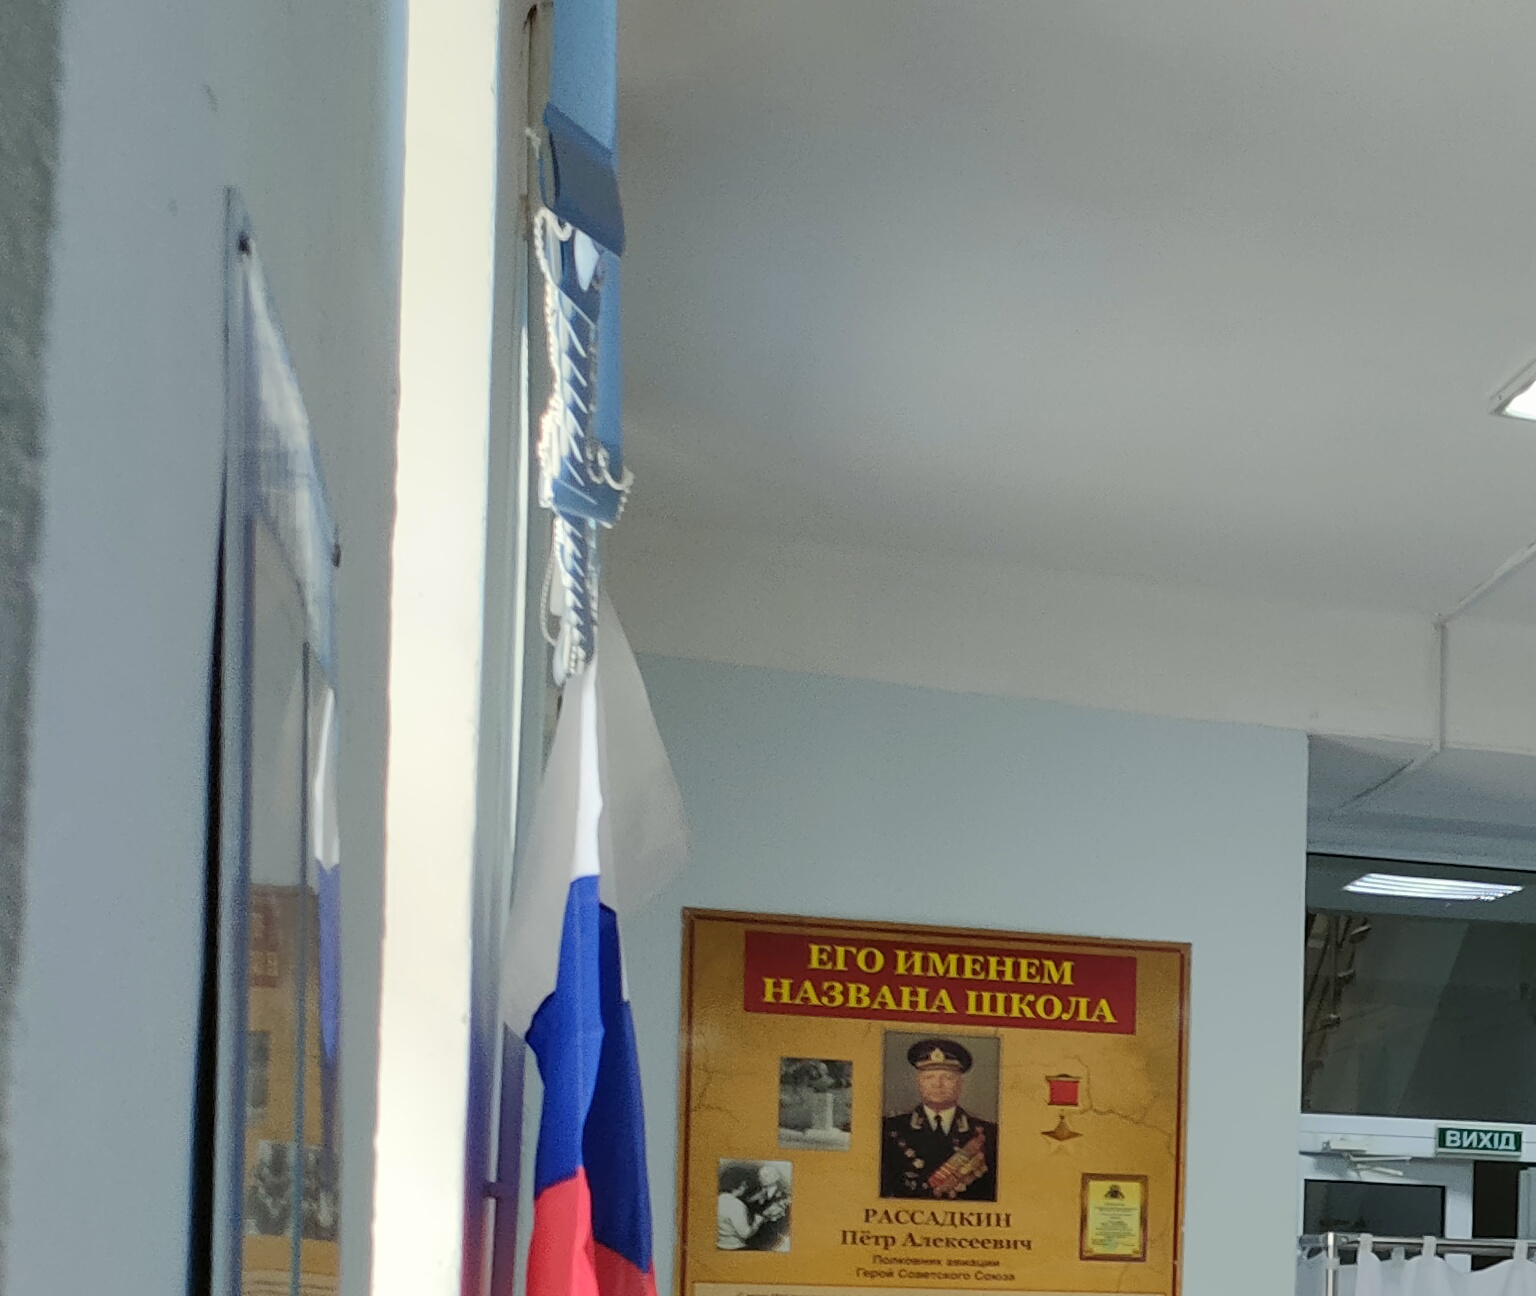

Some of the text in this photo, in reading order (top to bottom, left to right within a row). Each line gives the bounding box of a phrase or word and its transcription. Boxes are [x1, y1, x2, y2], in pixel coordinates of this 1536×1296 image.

[807, 942, 1075, 987] ЕГО ИМЕНЕМ
[762, 977, 1118, 1024] НАЗВАНА ШКОЛА
[1445, 1130, 1517, 1150] ВИХІД
[863, 1208, 1012, 1229] РАССАДКИН
[841, 1229, 1033, 1251] Пётр Алексеевич
[872, 1254, 1001, 1268] Полковник авиации
[856, 1267, 1016, 1282] Герой Советского Союза
